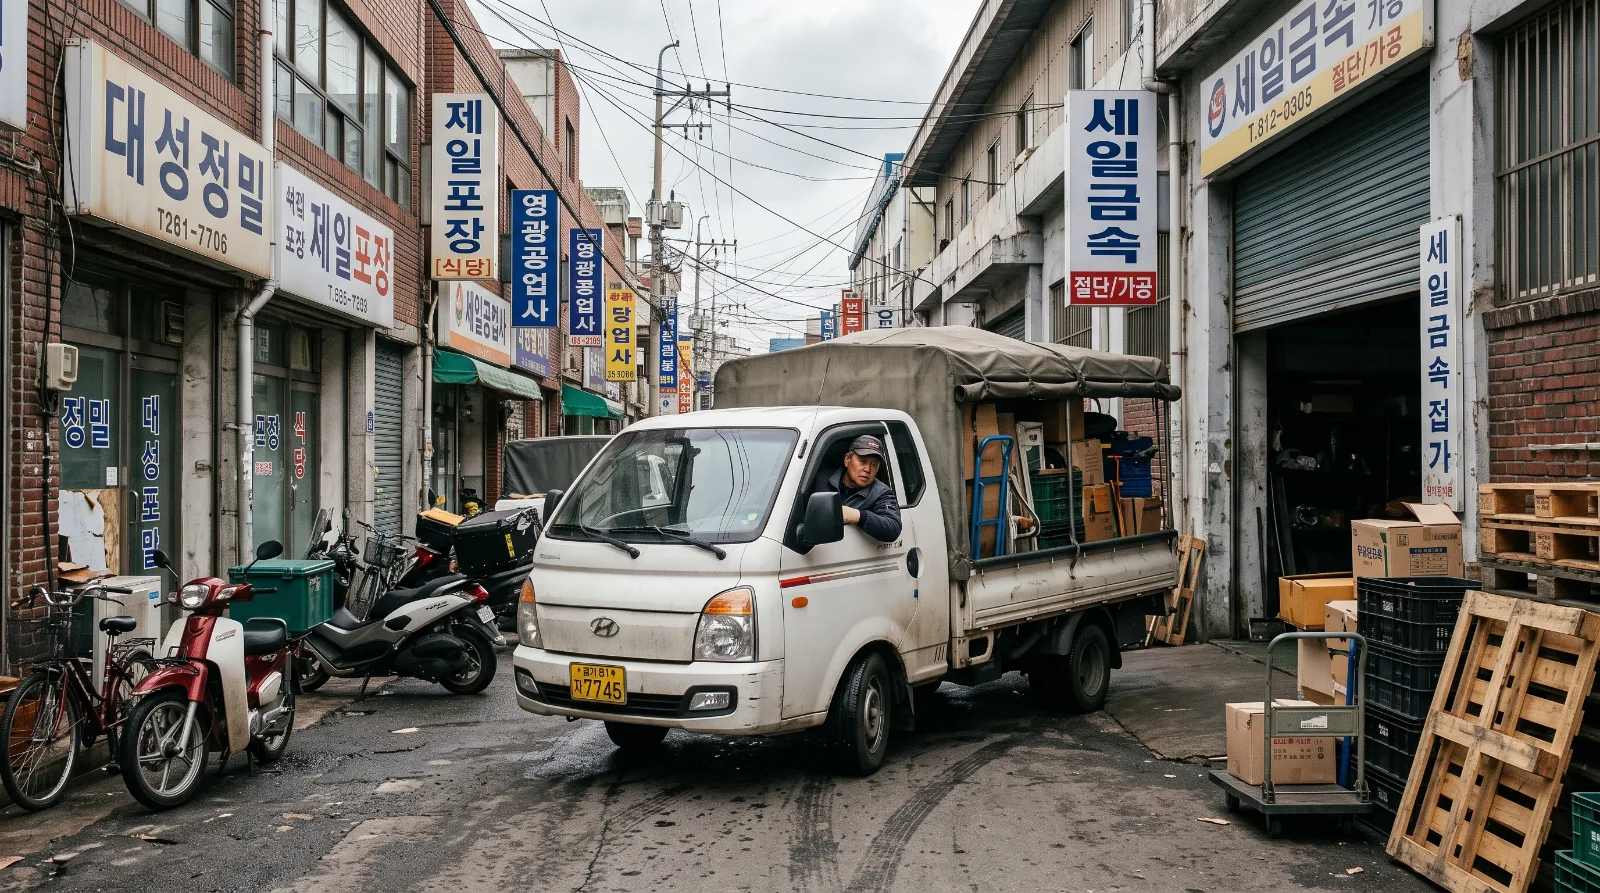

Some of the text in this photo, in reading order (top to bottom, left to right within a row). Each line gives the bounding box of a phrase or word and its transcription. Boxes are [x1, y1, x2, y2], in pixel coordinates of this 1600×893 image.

[1232, 0, 1356, 118] 세일금속
[1332, 24, 1403, 94] 절단/가공
[1248, 85, 1312, 143] T.812-0305
[105, 79, 264, 236] 대성정밀
[444, 99, 485, 254] 제일포장
[1084, 98, 1141, 264] 세일금속
[157, 207, 228, 255] T261-7706
[521, 194, 550, 322] 영광공업사
[436, 258, 492, 277] [식당]
[1073, 276, 1153, 299] 절단/가공
[611, 306, 632, 365] 당업사
[1426, 229, 1452, 474] 세일금속접가
[61, 397, 110, 448] 정밀
[294, 411, 306, 479] 식당
